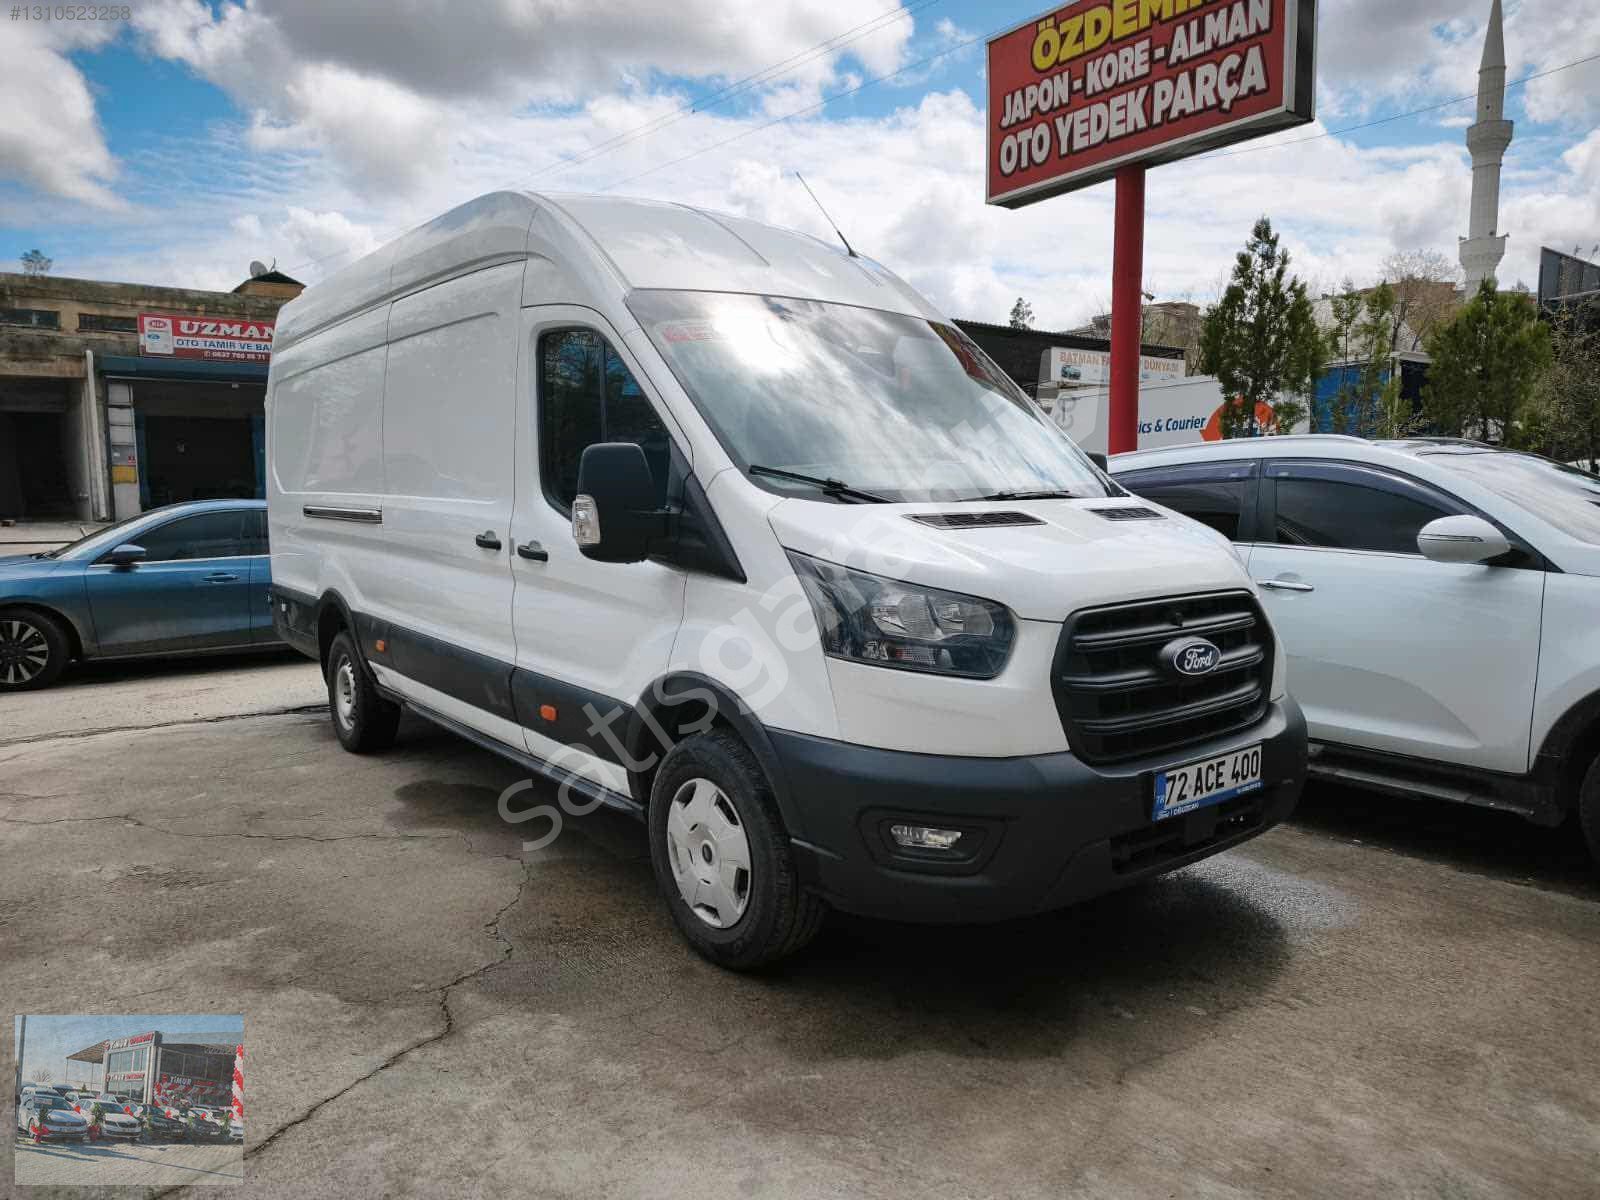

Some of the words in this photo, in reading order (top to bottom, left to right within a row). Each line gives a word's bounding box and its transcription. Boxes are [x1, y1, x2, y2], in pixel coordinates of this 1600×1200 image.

[1001, 71, 1070, 126] JAPON
[1086, 40, 1150, 95] KORE
[1169, 0, 1272, 65] ALMAN
[1031, 0, 1217, 71] ÖZDEM
[999, 126, 1050, 176] OTO
[1054, 88, 1150, 156] YEDEK
[1152, 46, 1267, 124] PARÇA
[176, 339, 199, 347] OTO
[239, 342, 254, 350] VE
[255, 343, 272, 352] BA
[1165, 415, 1206, 432] Courier
[1184, 647, 1213, 671] Ford
[1165, 772, 1188, 806] 72
[1193, 759, 1226, 797] ACE
[1231, 750, 1260, 783] 400
